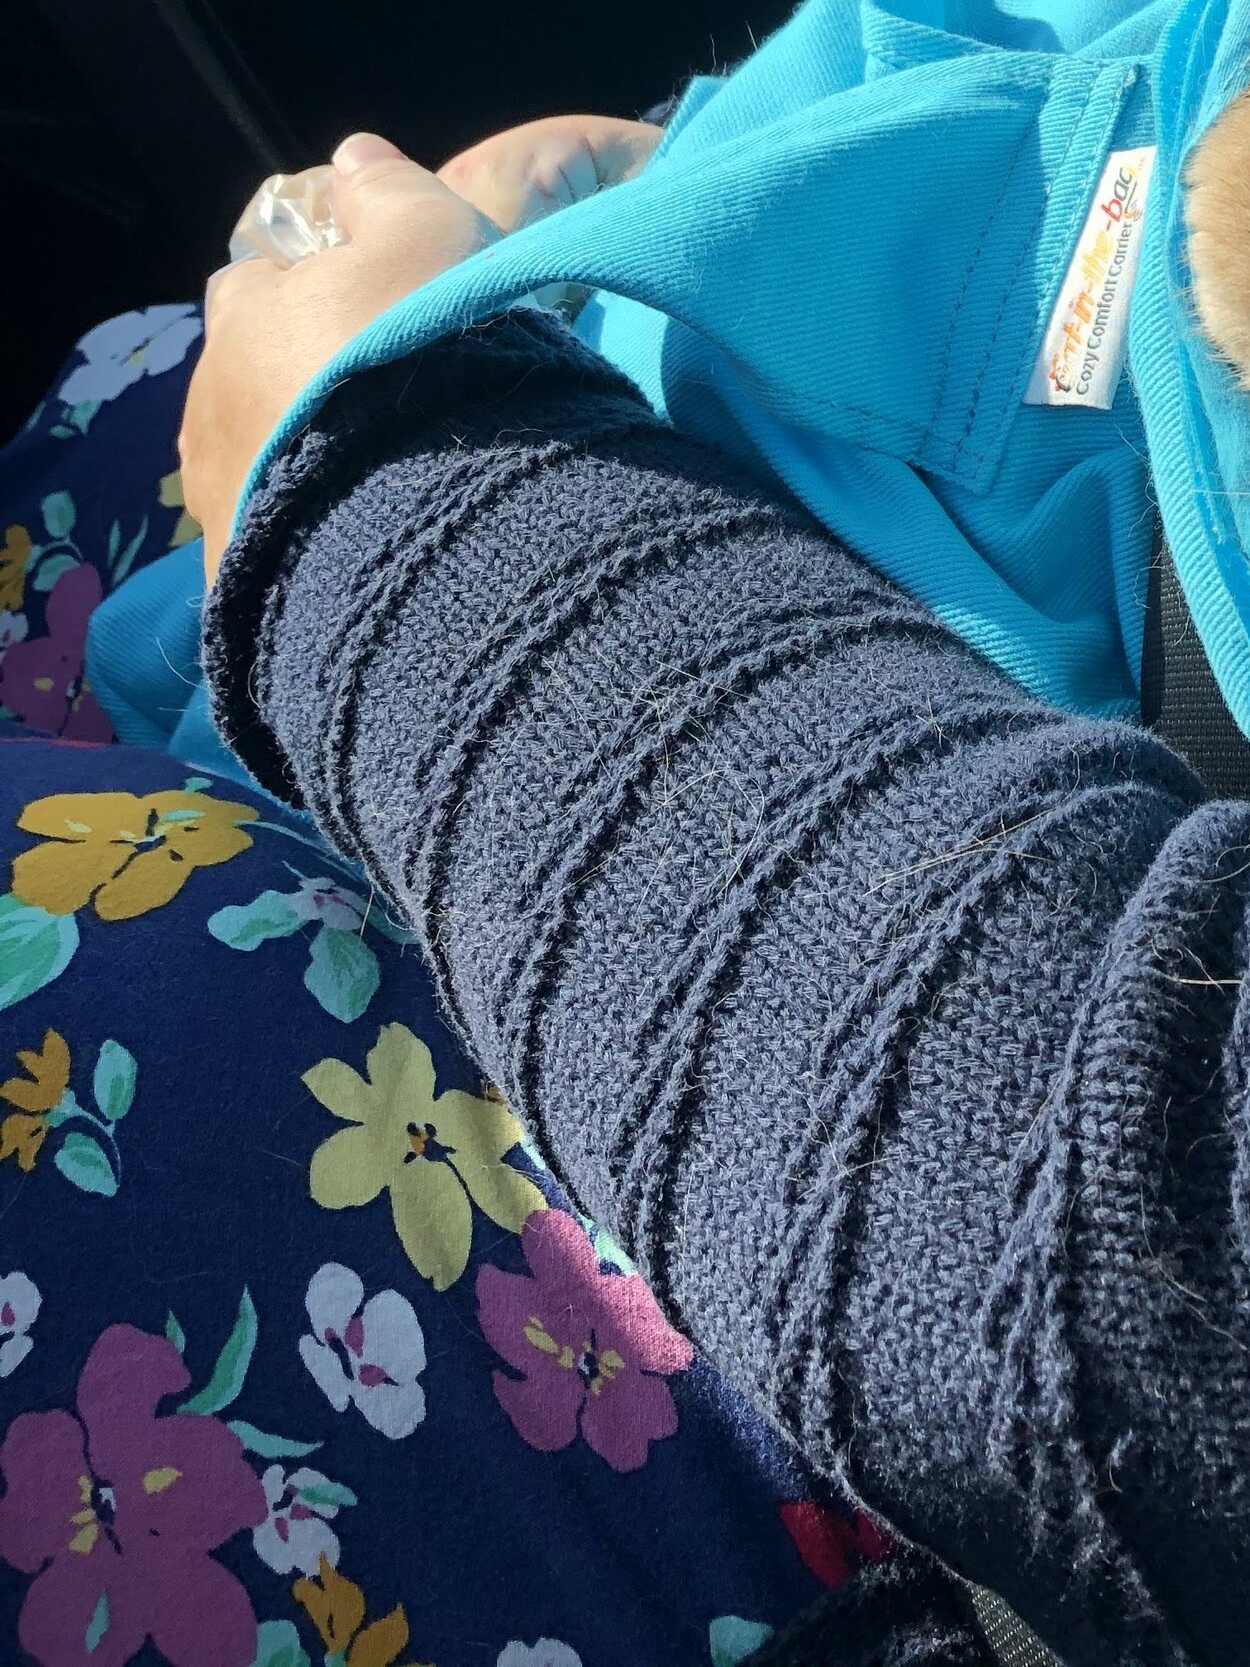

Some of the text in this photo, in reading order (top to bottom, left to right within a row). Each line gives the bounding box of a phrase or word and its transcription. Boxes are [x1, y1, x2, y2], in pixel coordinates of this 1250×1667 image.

[1076, 221, 1133, 395] Cozy Comfort Carrier
